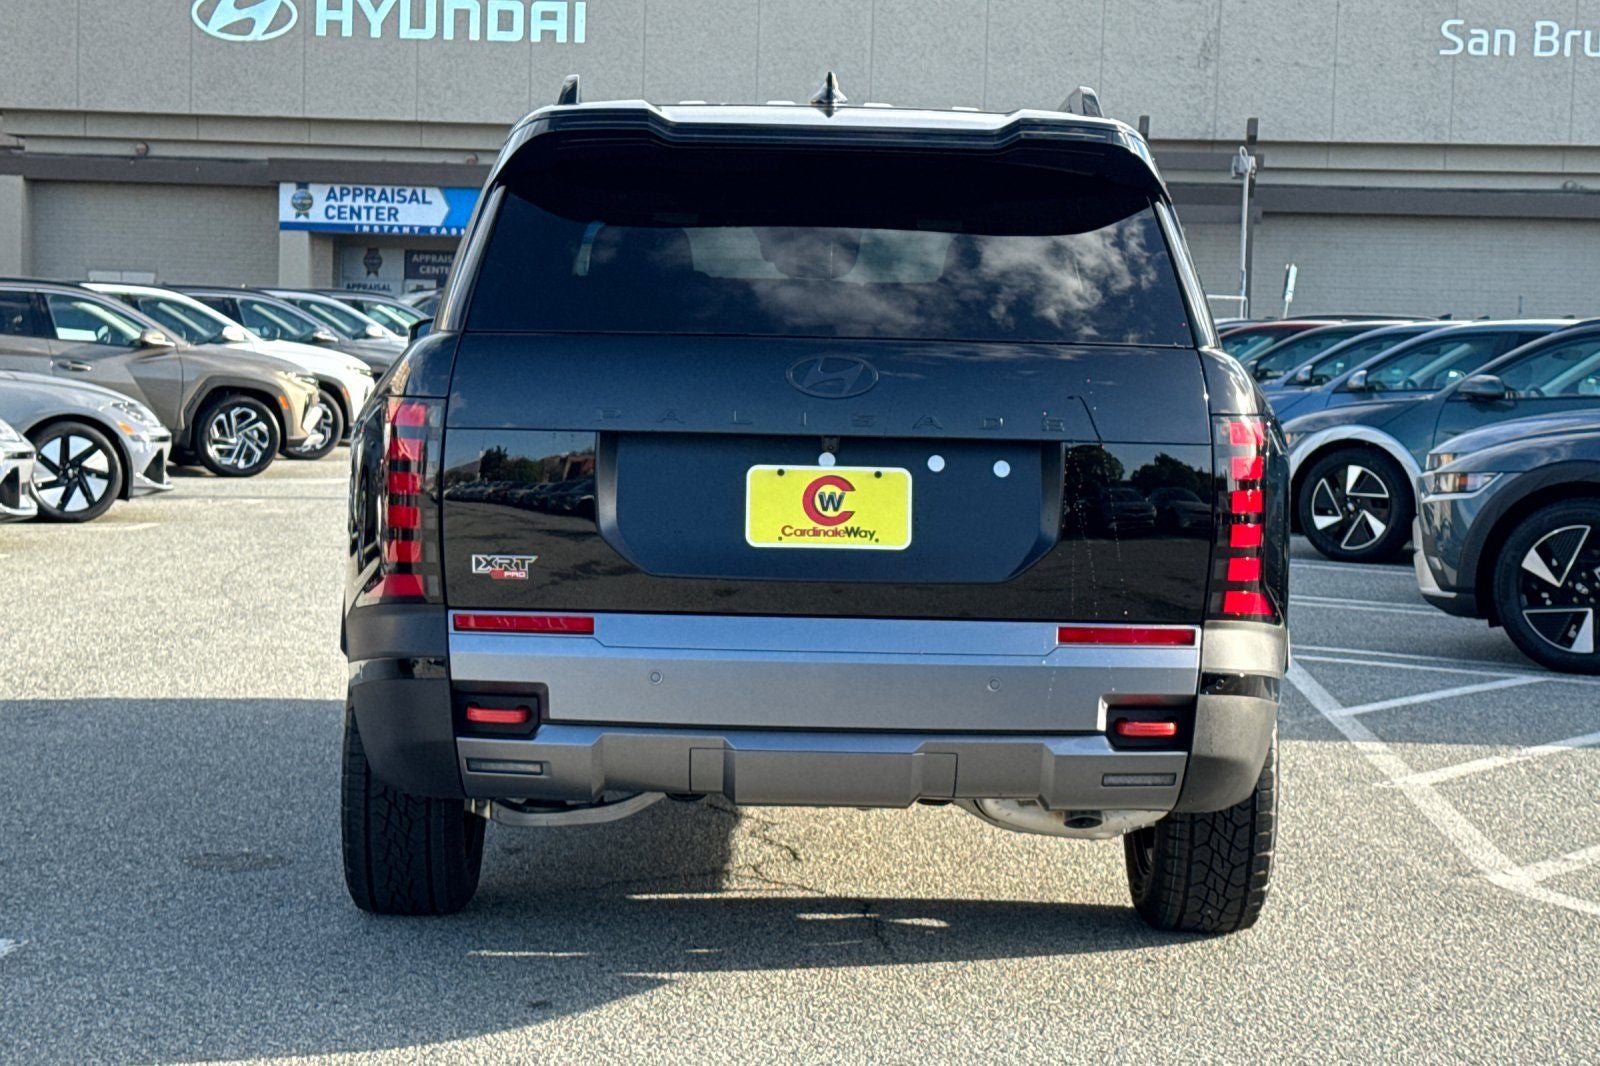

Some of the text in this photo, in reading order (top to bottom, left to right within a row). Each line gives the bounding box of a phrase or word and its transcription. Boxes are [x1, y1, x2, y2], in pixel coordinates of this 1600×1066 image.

[315, 0, 587, 44] HYUNDAI
[1439, 19, 1600, 57] San Bru
[325, 186, 433, 205] APPRAISAL
[324, 204, 399, 222] CENTER
[354, 225, 420, 235] INSTANT
[781, 524, 877, 541] CardinaleWay
[472, 554, 539, 574] XRT
